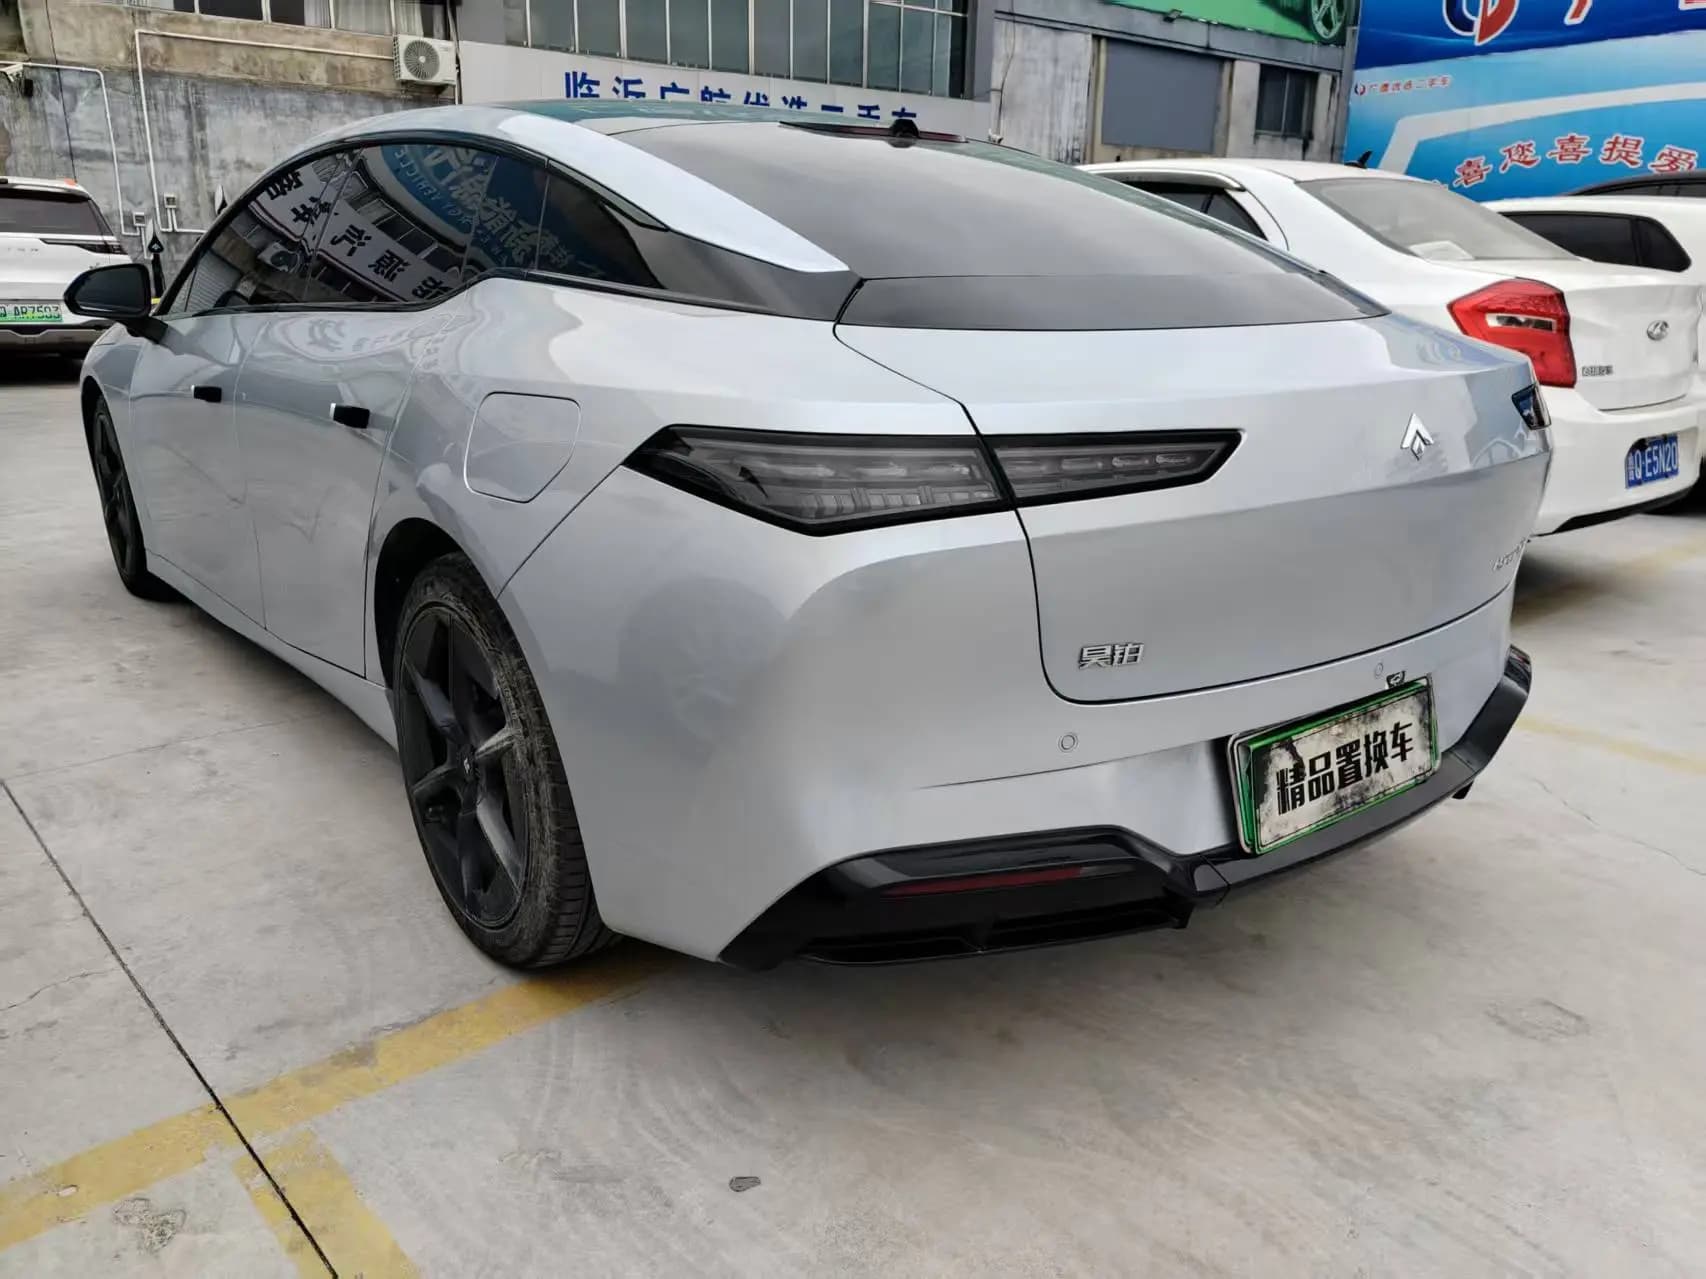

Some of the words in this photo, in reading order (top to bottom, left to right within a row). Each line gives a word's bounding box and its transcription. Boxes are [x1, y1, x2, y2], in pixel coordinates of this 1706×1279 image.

[1079, 643, 1144, 669] 昊铂
[1276, 721, 1414, 816] 精品置换车
